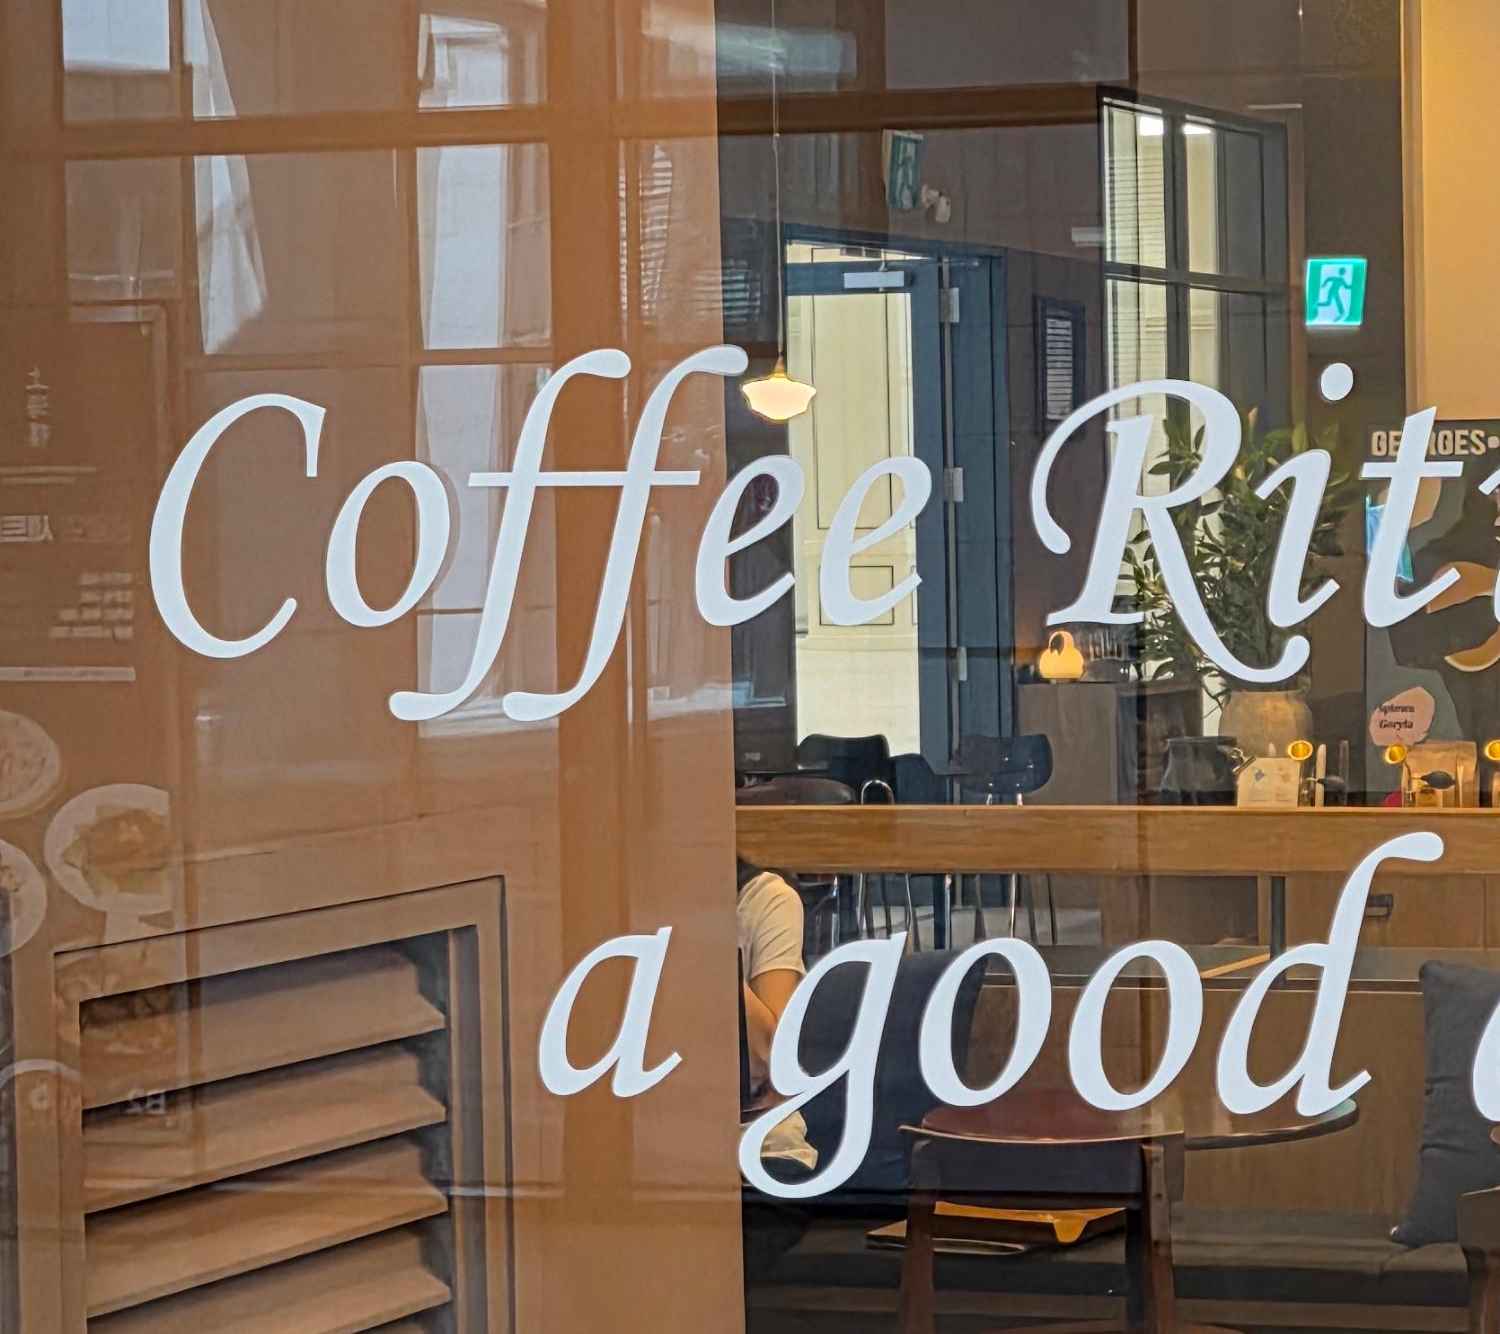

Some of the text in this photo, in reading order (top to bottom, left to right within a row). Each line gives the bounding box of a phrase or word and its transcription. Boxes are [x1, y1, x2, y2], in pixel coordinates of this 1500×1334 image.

[148, 344, 933, 723] Coffee
[539, 926, 682, 1098] a
[738, 831, 1445, 1200] good
